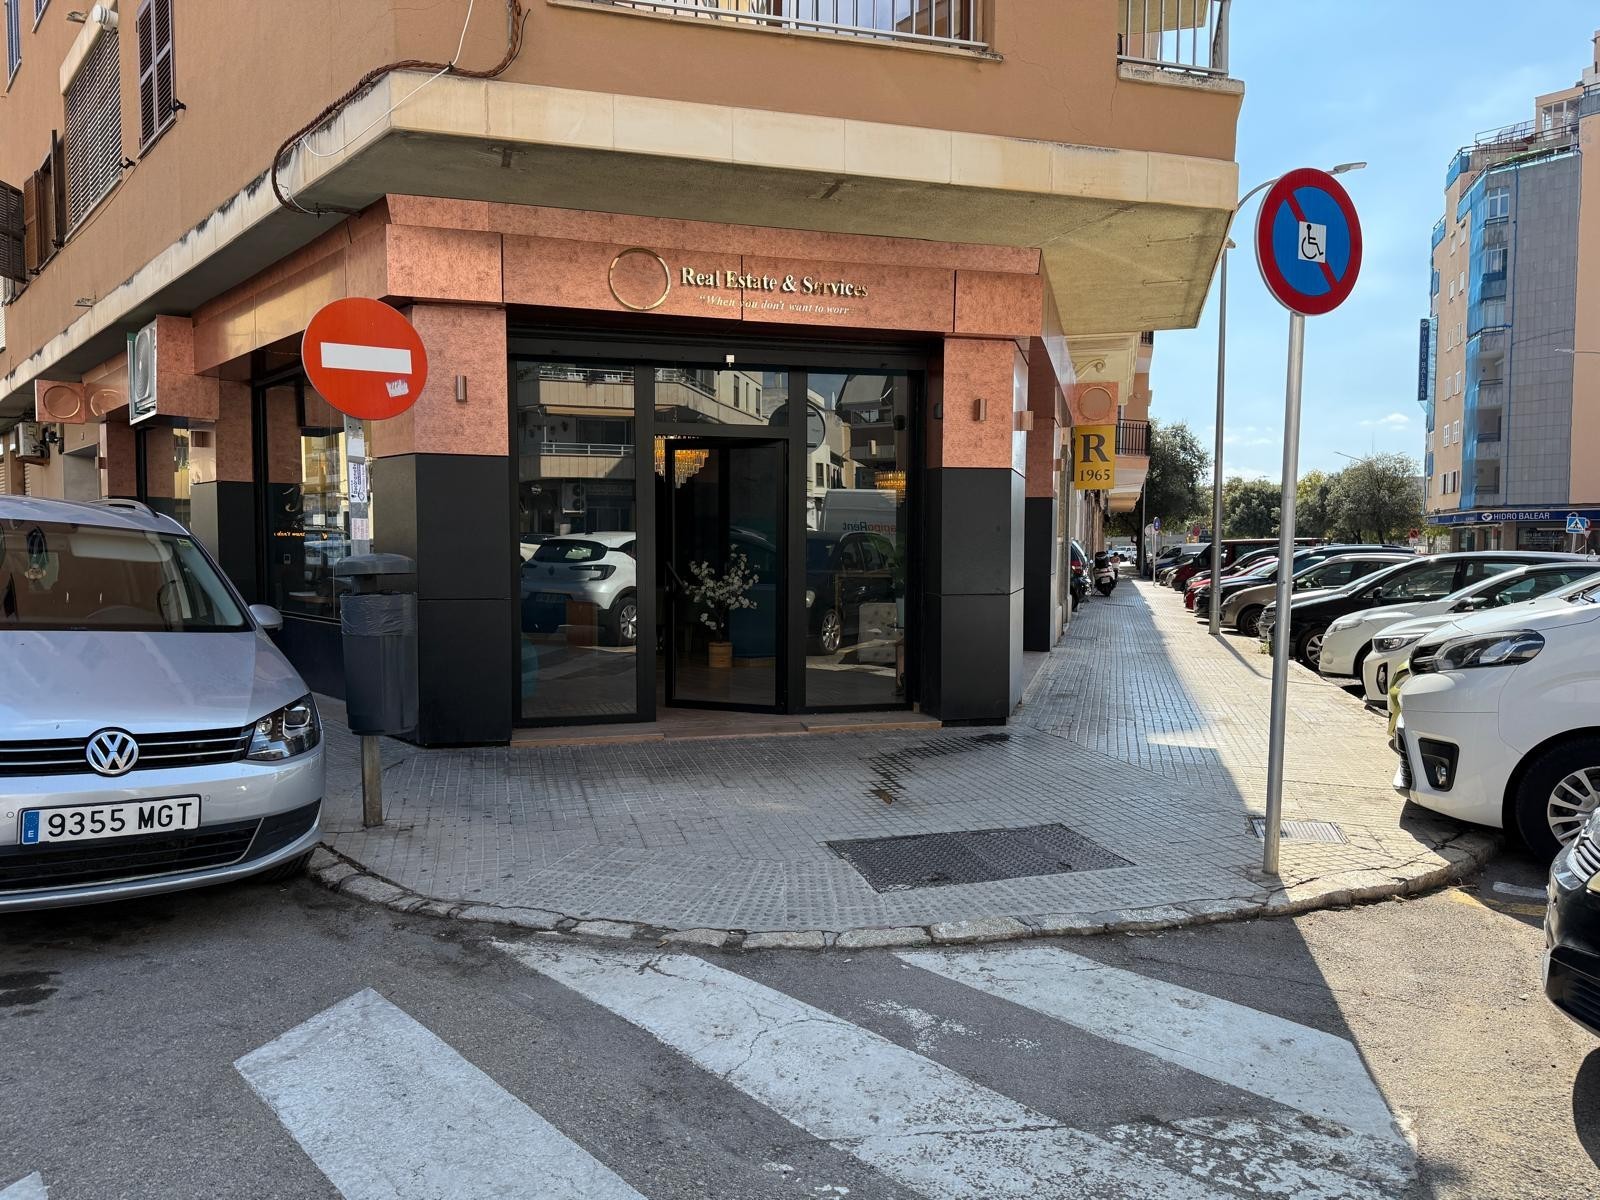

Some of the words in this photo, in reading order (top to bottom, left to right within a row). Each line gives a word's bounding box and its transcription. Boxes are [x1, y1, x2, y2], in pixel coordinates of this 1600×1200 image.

[681, 266, 720, 287] Real
[725, 270, 777, 290] Estate
[782, 274, 797, 292] &
[803, 275, 868, 297] Services
[789, 303, 814, 313] want
[814, 304, 825, 313] to
[1080, 433, 1110, 463] R
[1080, 469, 1110, 481] 1965
[1493, 512, 1517, 520] HIDRO
[1519, 512, 1550, 520] BALEAR
[47, 809, 126, 837] 9355
[137, 802, 193, 831] MGT
